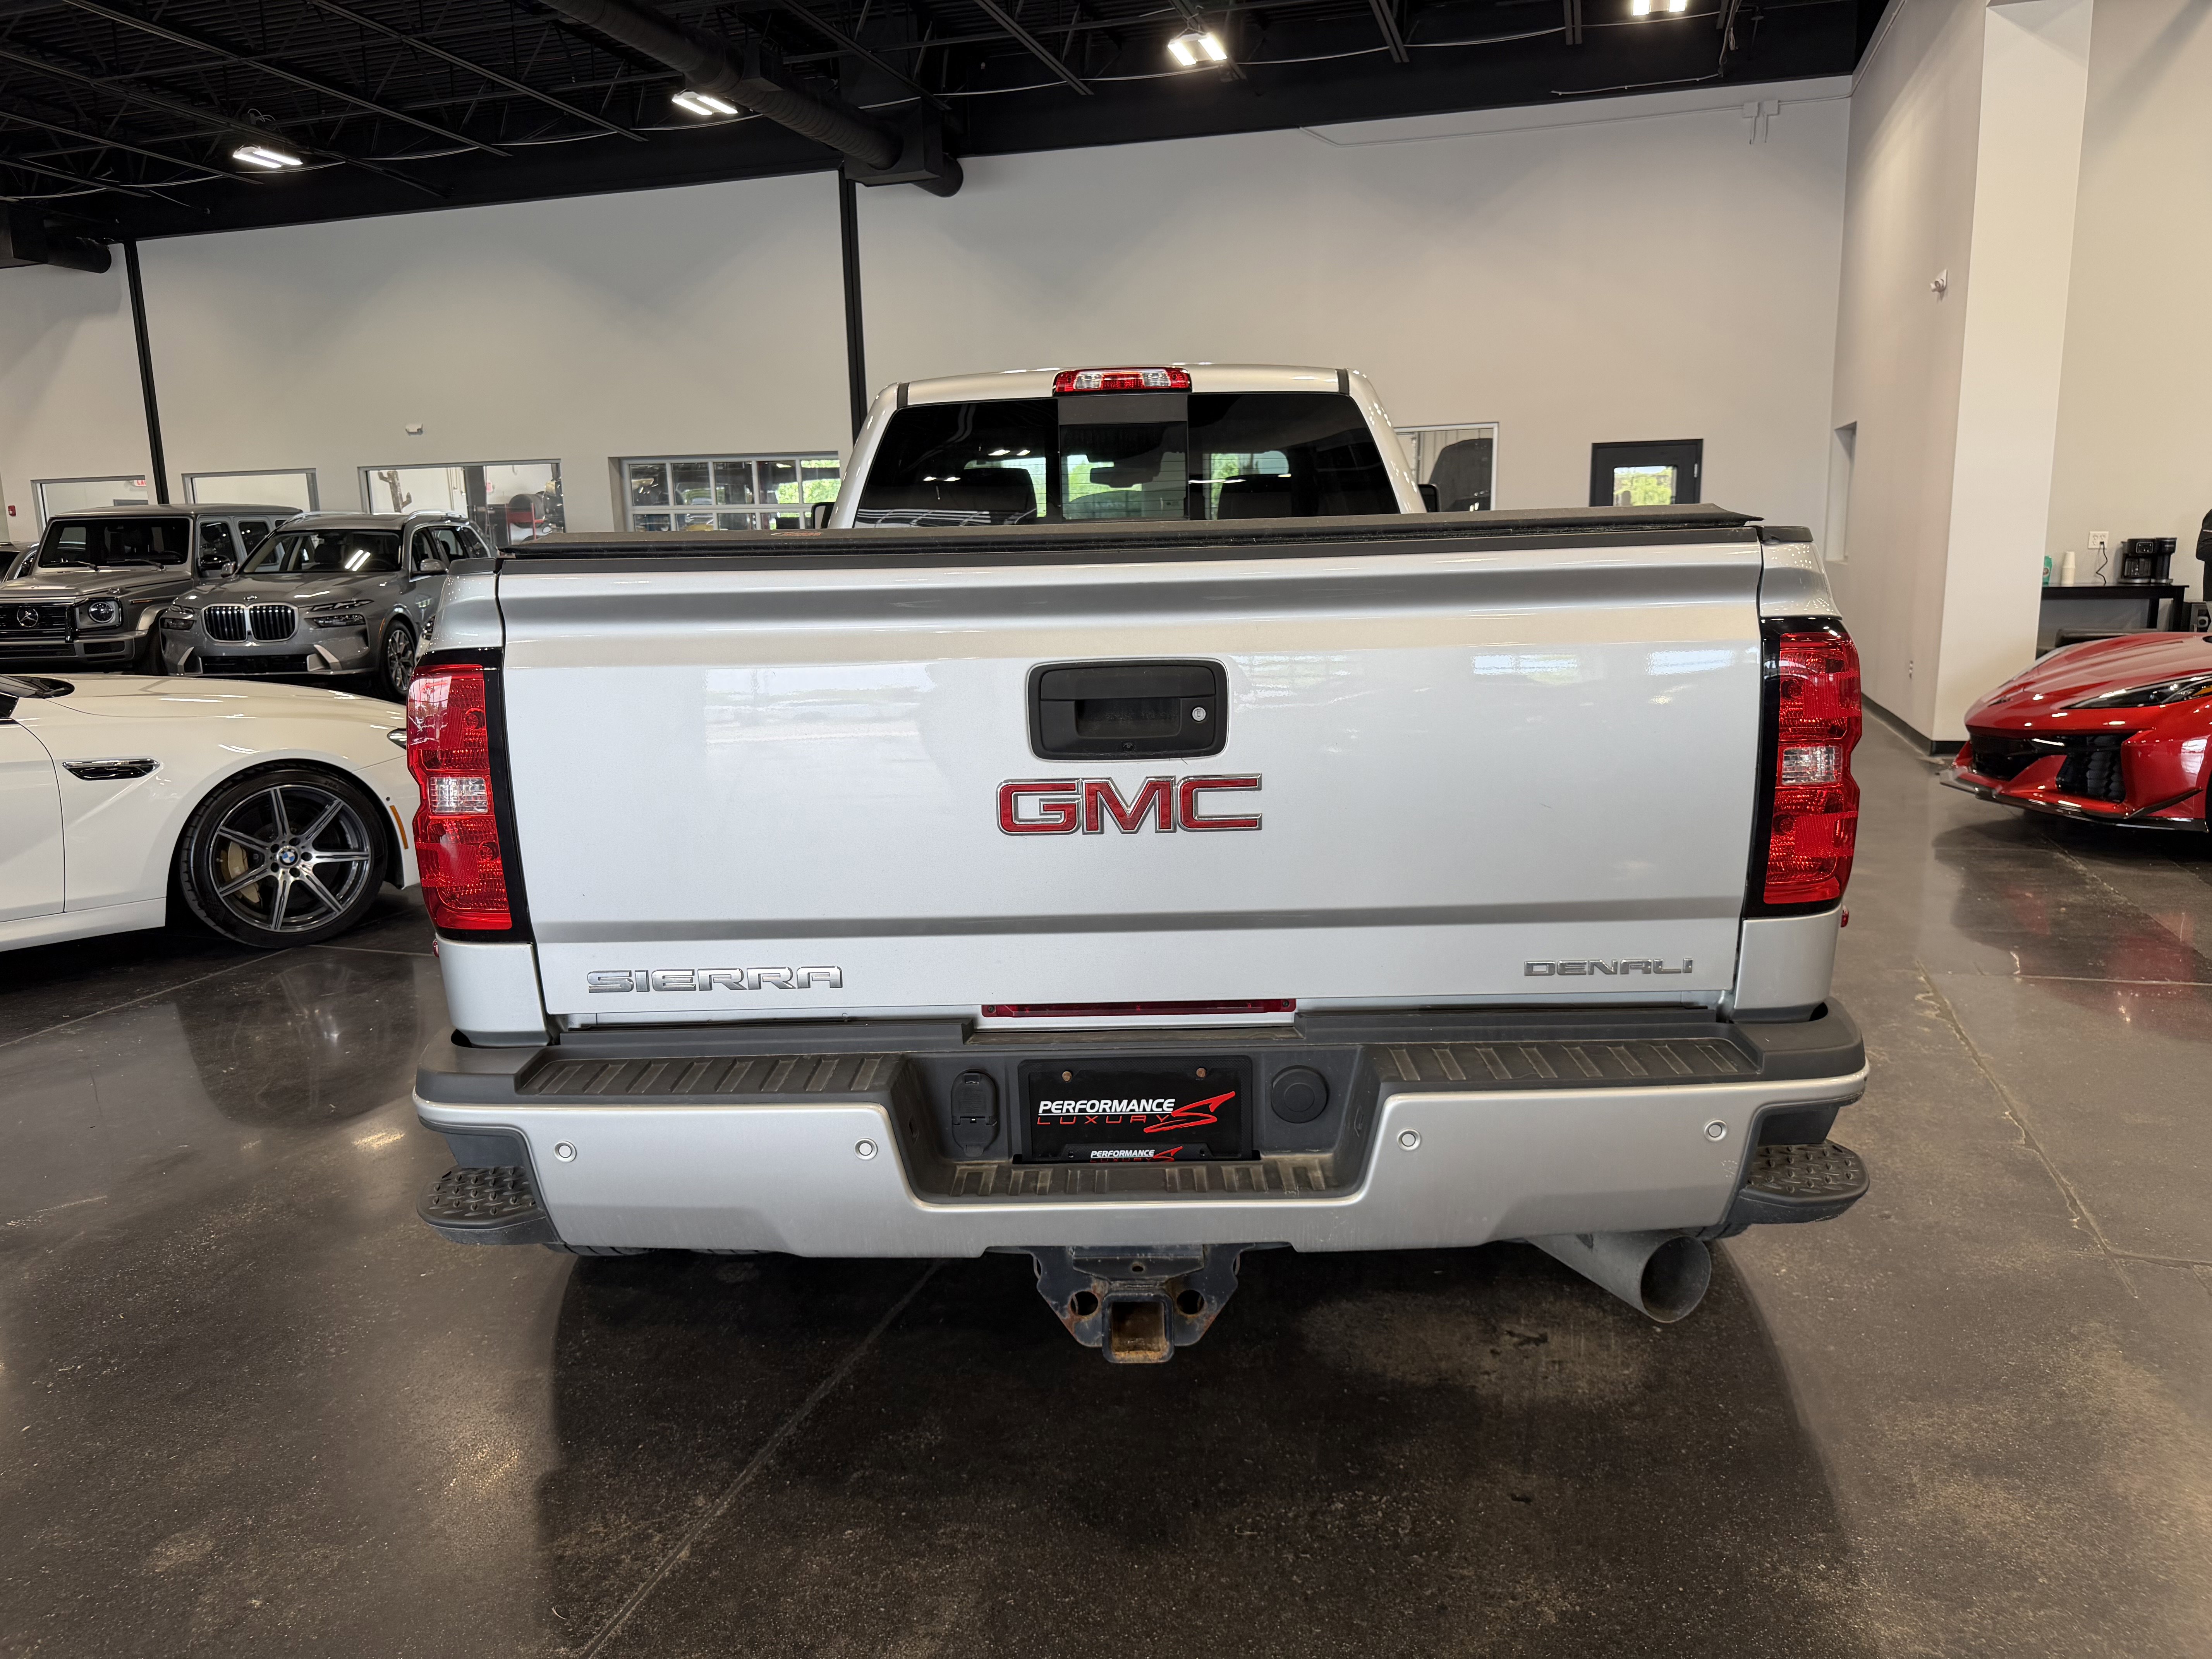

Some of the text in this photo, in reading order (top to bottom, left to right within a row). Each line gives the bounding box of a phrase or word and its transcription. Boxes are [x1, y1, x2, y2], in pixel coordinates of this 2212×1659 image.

[996, 773, 1262, 835] GMC
[1524, 957, 1693, 976] DENALI
[587, 965, 842, 993] SIERRA
[1039, 1098, 1175, 1114] PERFORMANCE
[1037, 1115, 1170, 1125] LUXURY
[1091, 1149, 1155, 1158] PERFORMANCE
